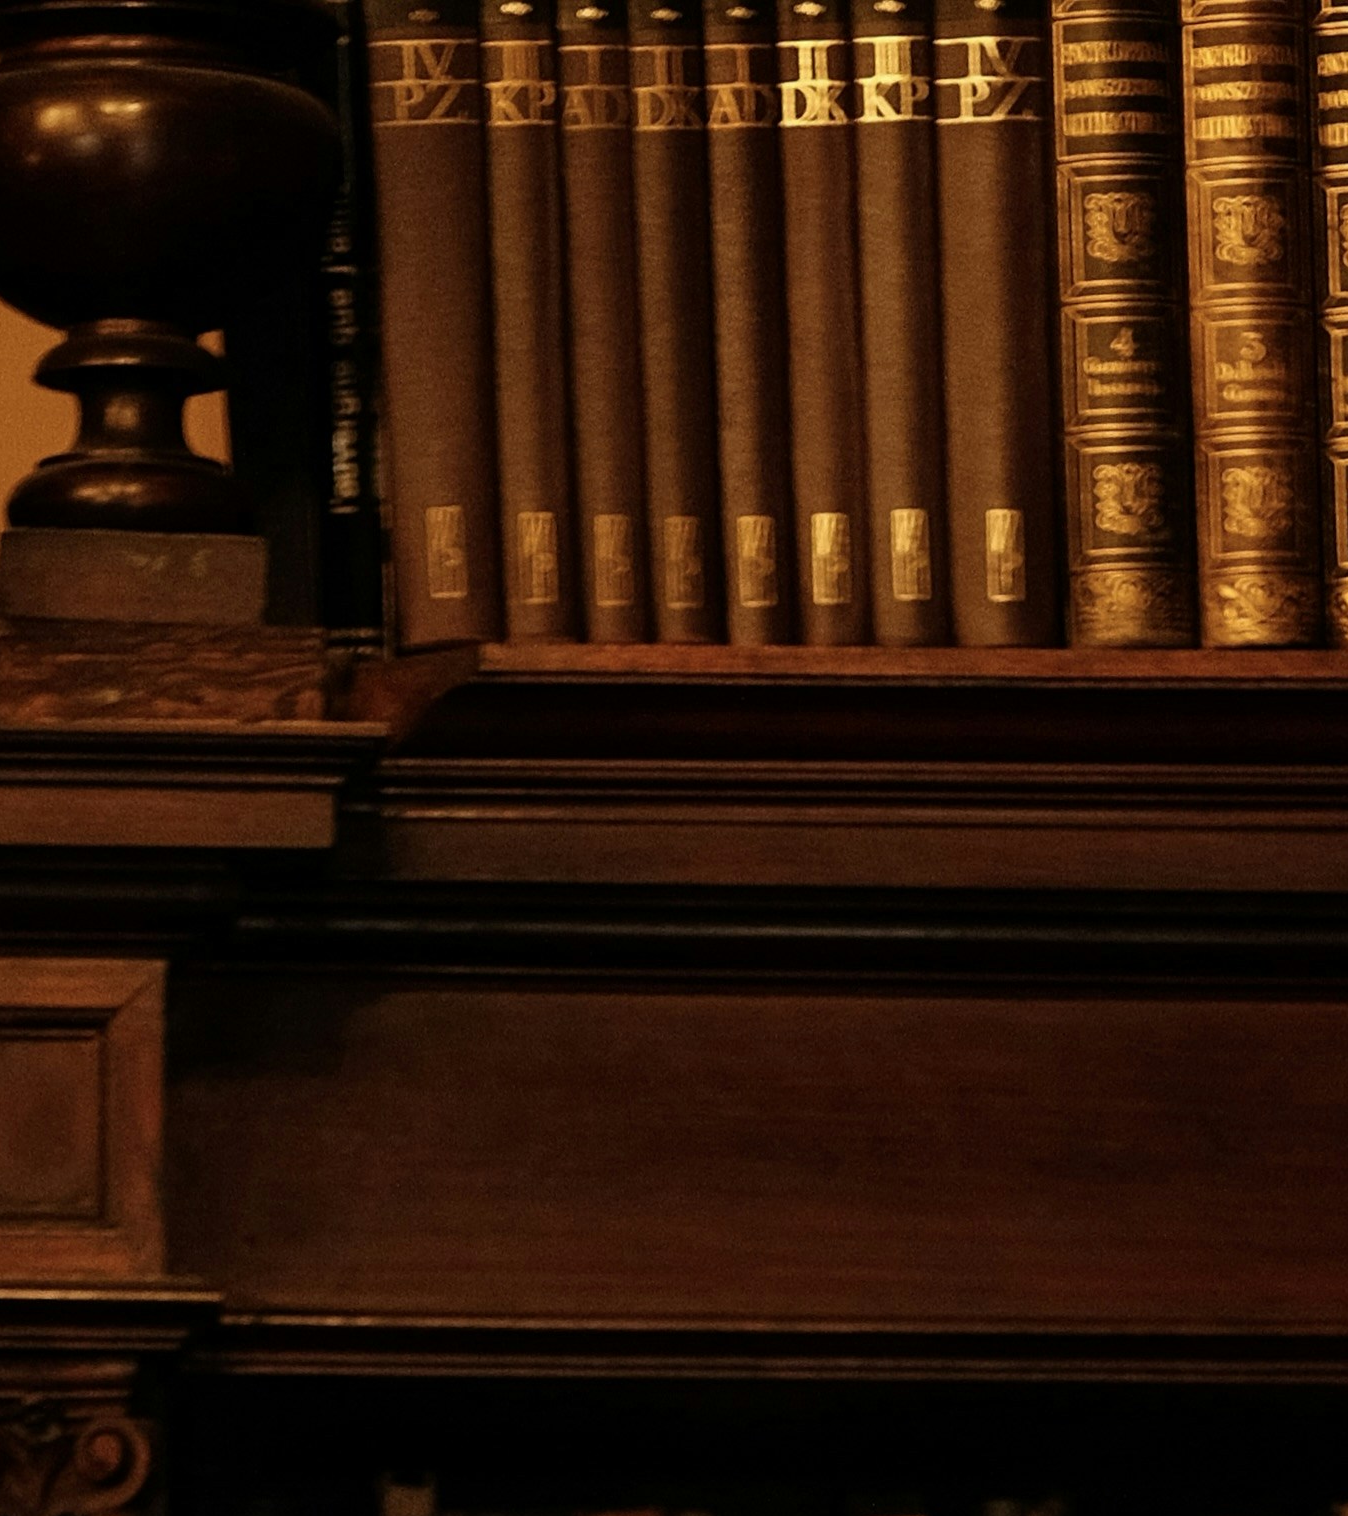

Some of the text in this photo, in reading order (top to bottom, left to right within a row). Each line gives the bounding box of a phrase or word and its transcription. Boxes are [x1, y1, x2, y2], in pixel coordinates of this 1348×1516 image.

[798, 45, 830, 82] II
[873, 42, 912, 79] III
[968, 42, 1024, 79] IV
[780, 84, 847, 123] DK
[856, 79, 929, 118] KP
